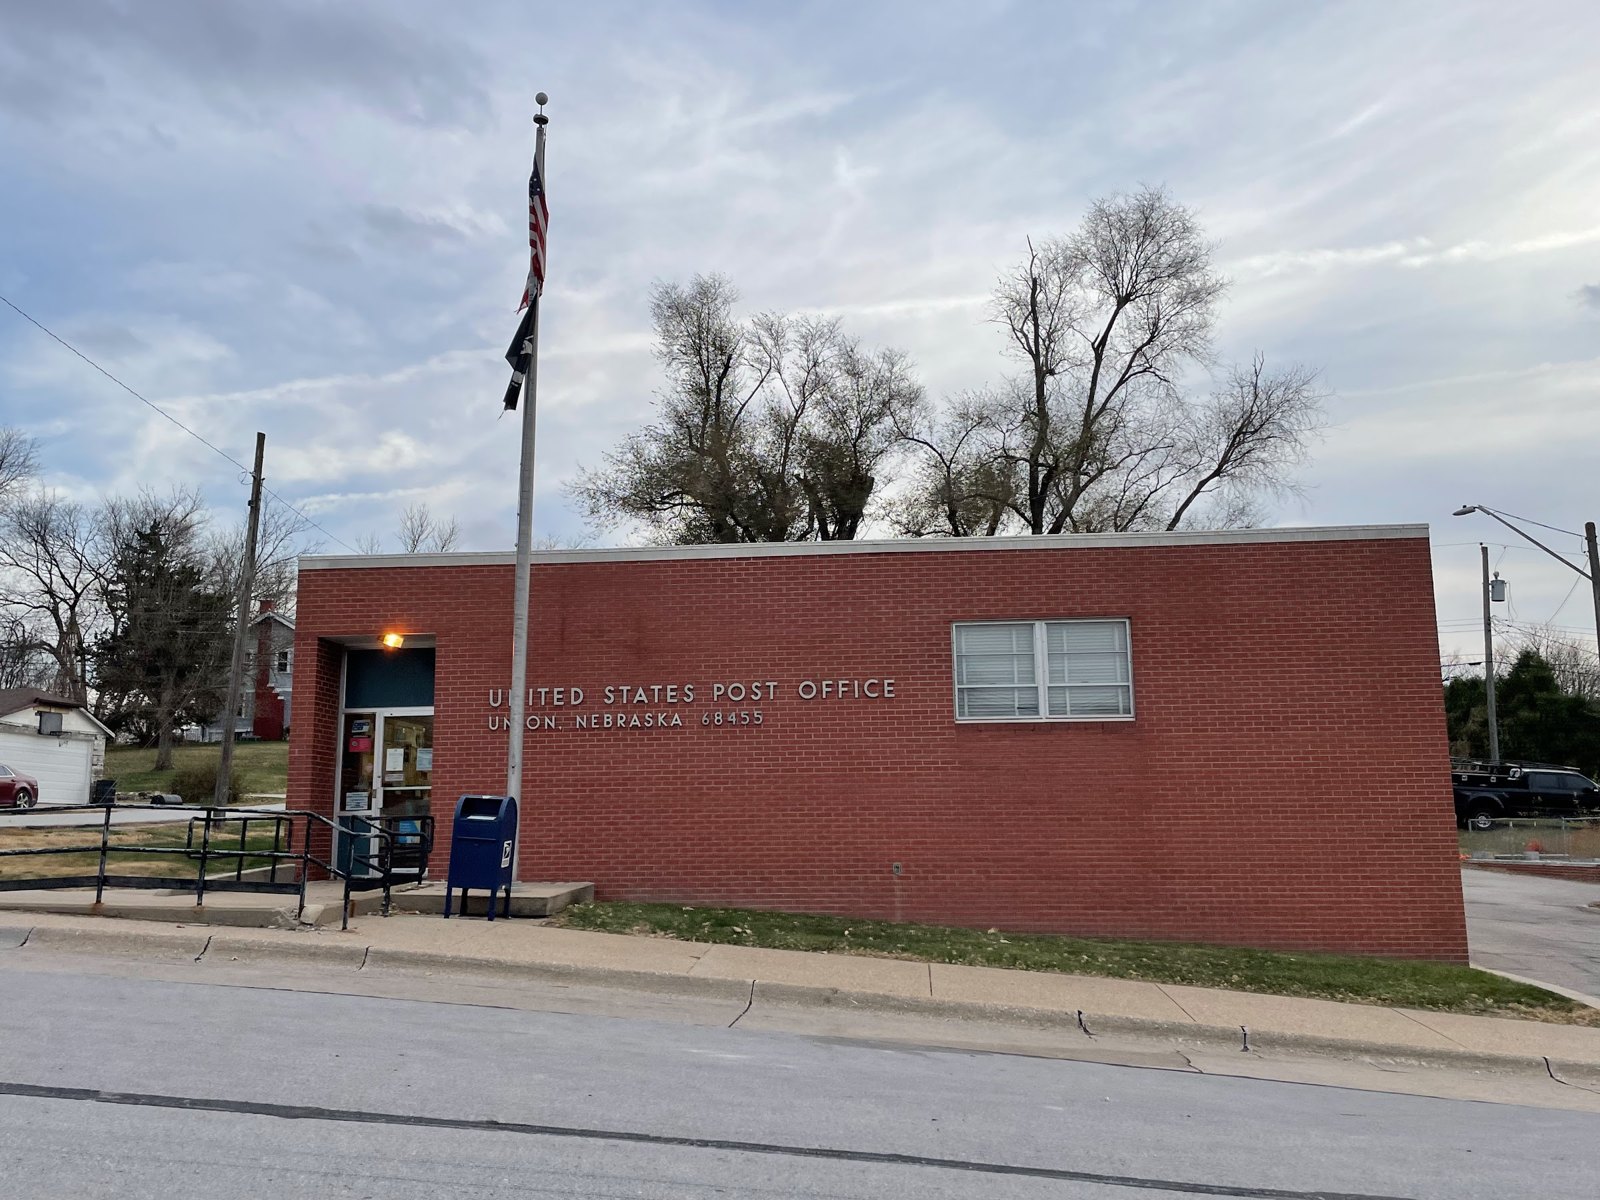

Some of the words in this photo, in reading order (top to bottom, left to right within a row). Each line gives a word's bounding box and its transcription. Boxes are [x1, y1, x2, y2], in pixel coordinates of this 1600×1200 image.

[489, 687, 584, 707] UITED
[603, 684, 695, 704] STATES
[713, 682, 778, 701] POST
[798, 679, 896, 699] OFFICE
[488, 715, 562, 731] UNON,
[576, 712, 683, 729] NEBRASKA
[701, 711, 763, 726] 68455
